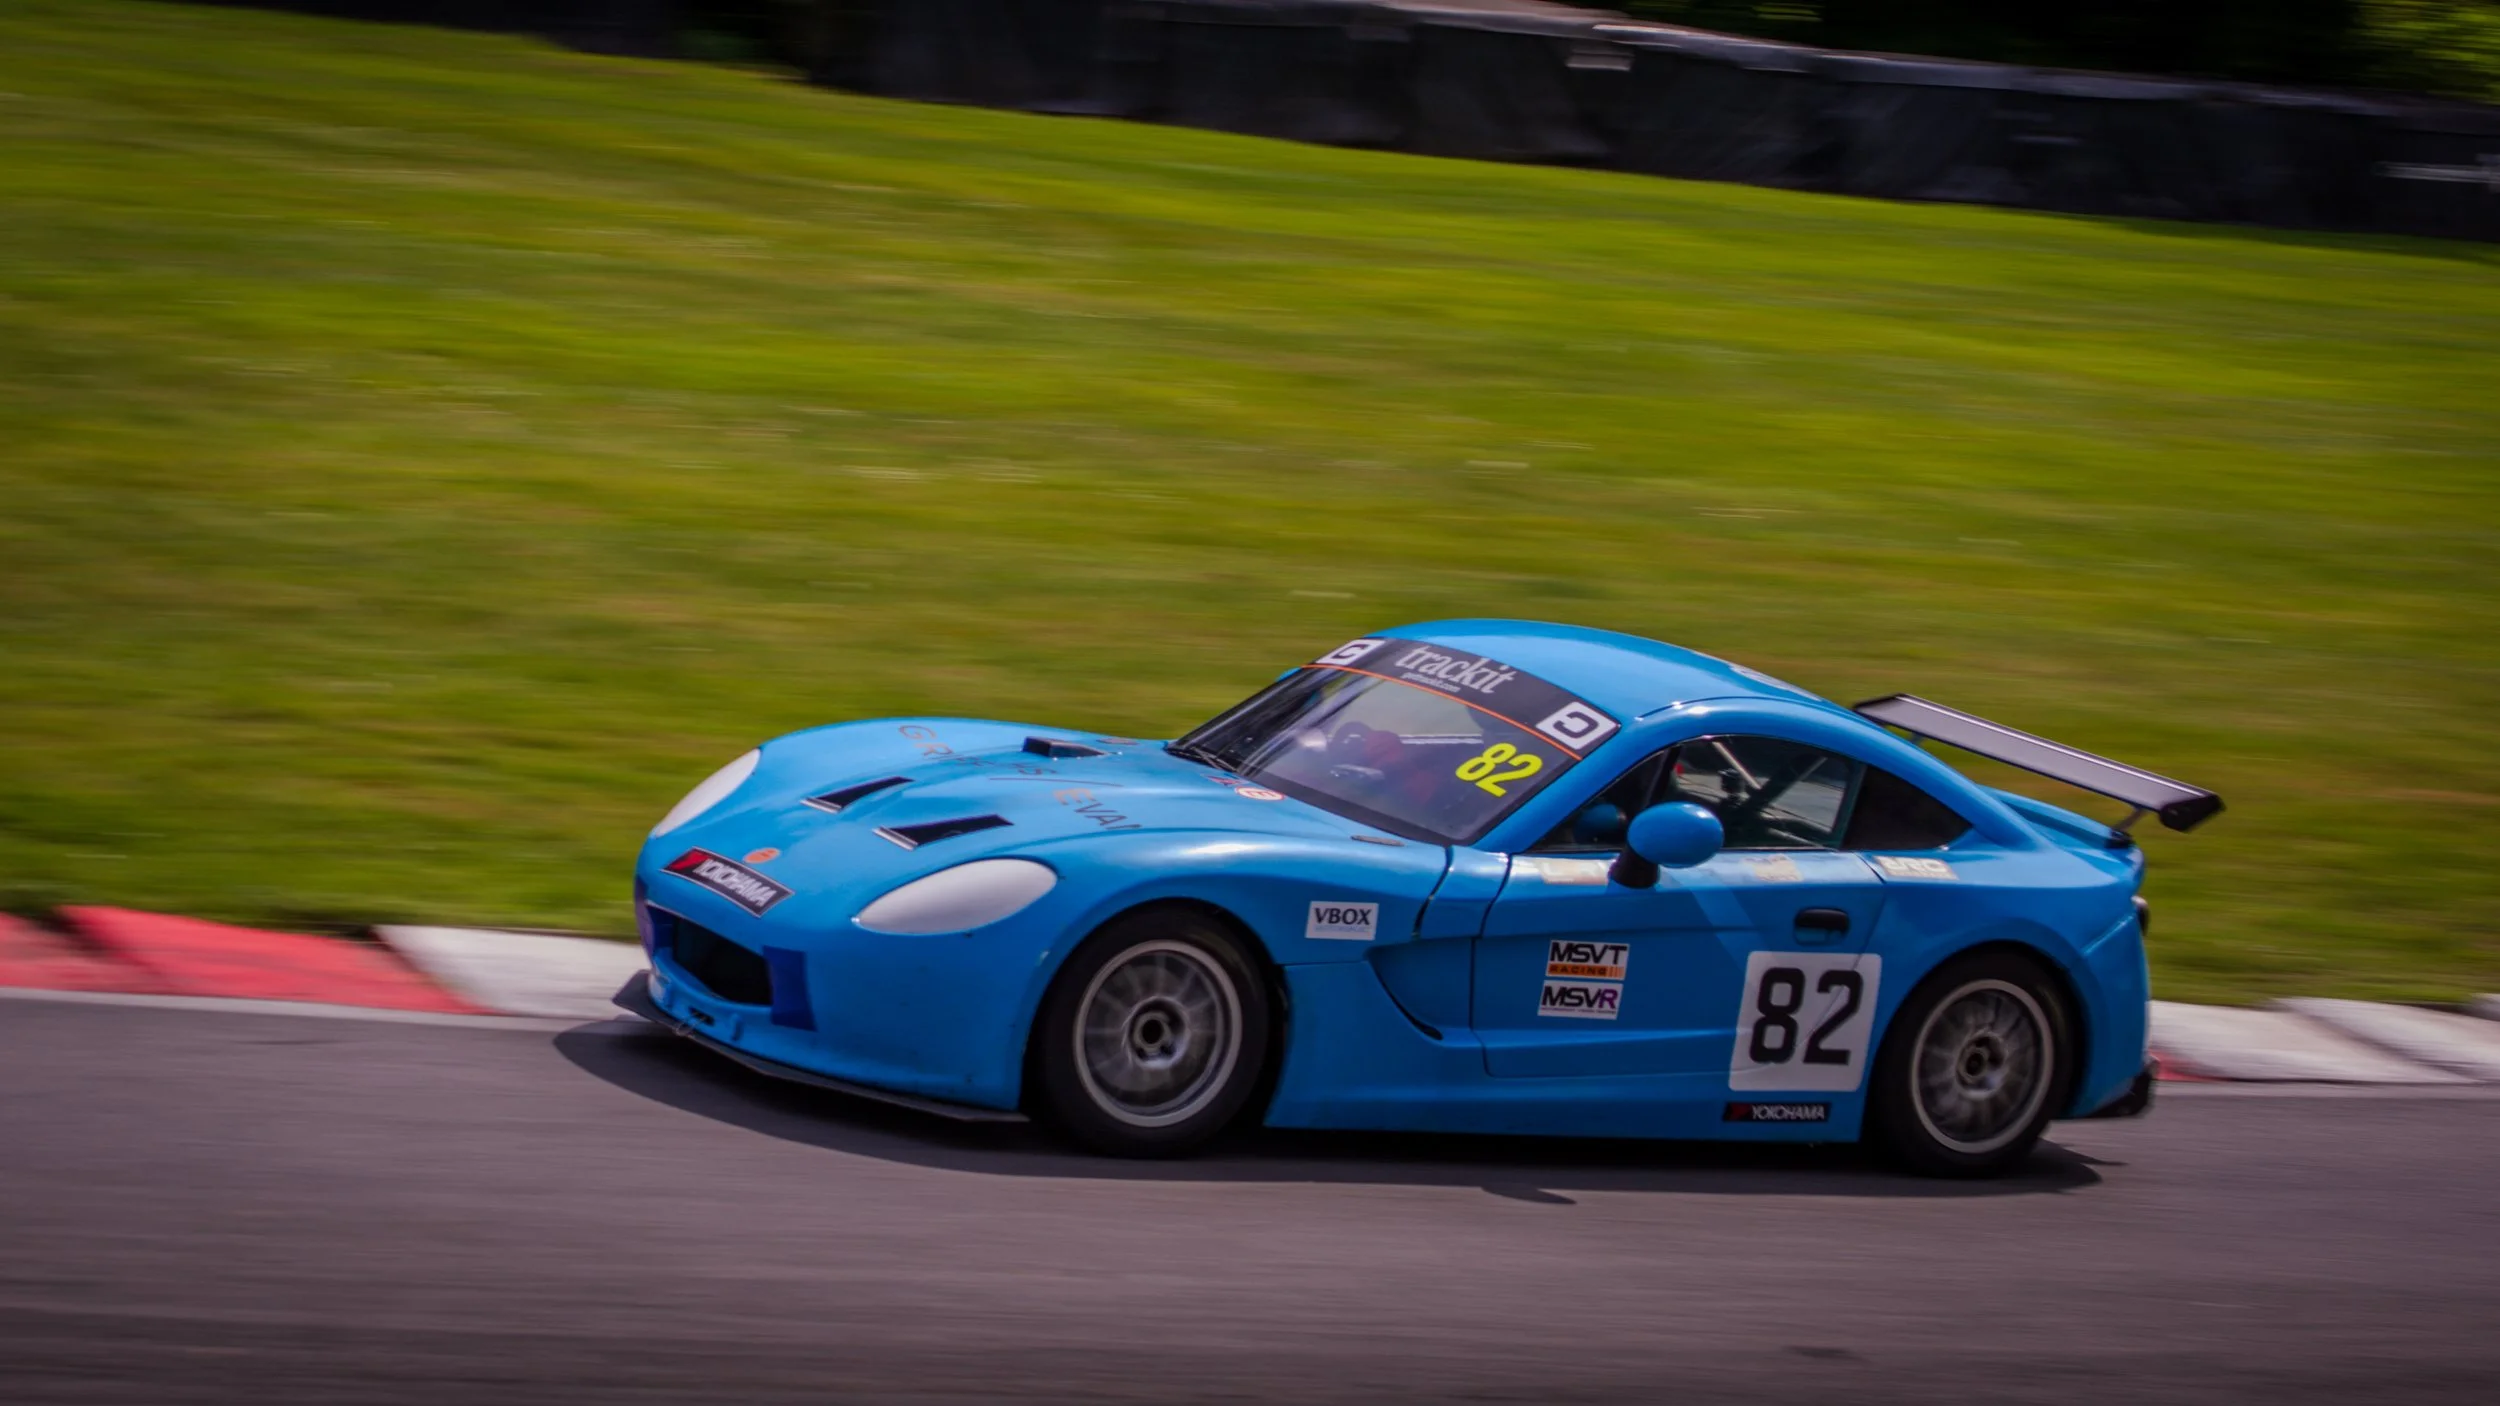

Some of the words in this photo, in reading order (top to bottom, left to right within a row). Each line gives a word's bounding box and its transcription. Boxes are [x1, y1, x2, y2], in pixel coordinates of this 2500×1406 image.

[1394, 645, 1517, 694] trackit
[1455, 742, 1544, 798] 82
[1314, 907, 1373, 926] VBOX
[1550, 941, 1628, 966] MSVT
[1549, 963, 1608, 977] RACING
[1541, 985, 1619, 1010] MSVR
[1749, 967, 1864, 1066] 82
[1752, 1104, 1825, 1121] YOKOHAMA
